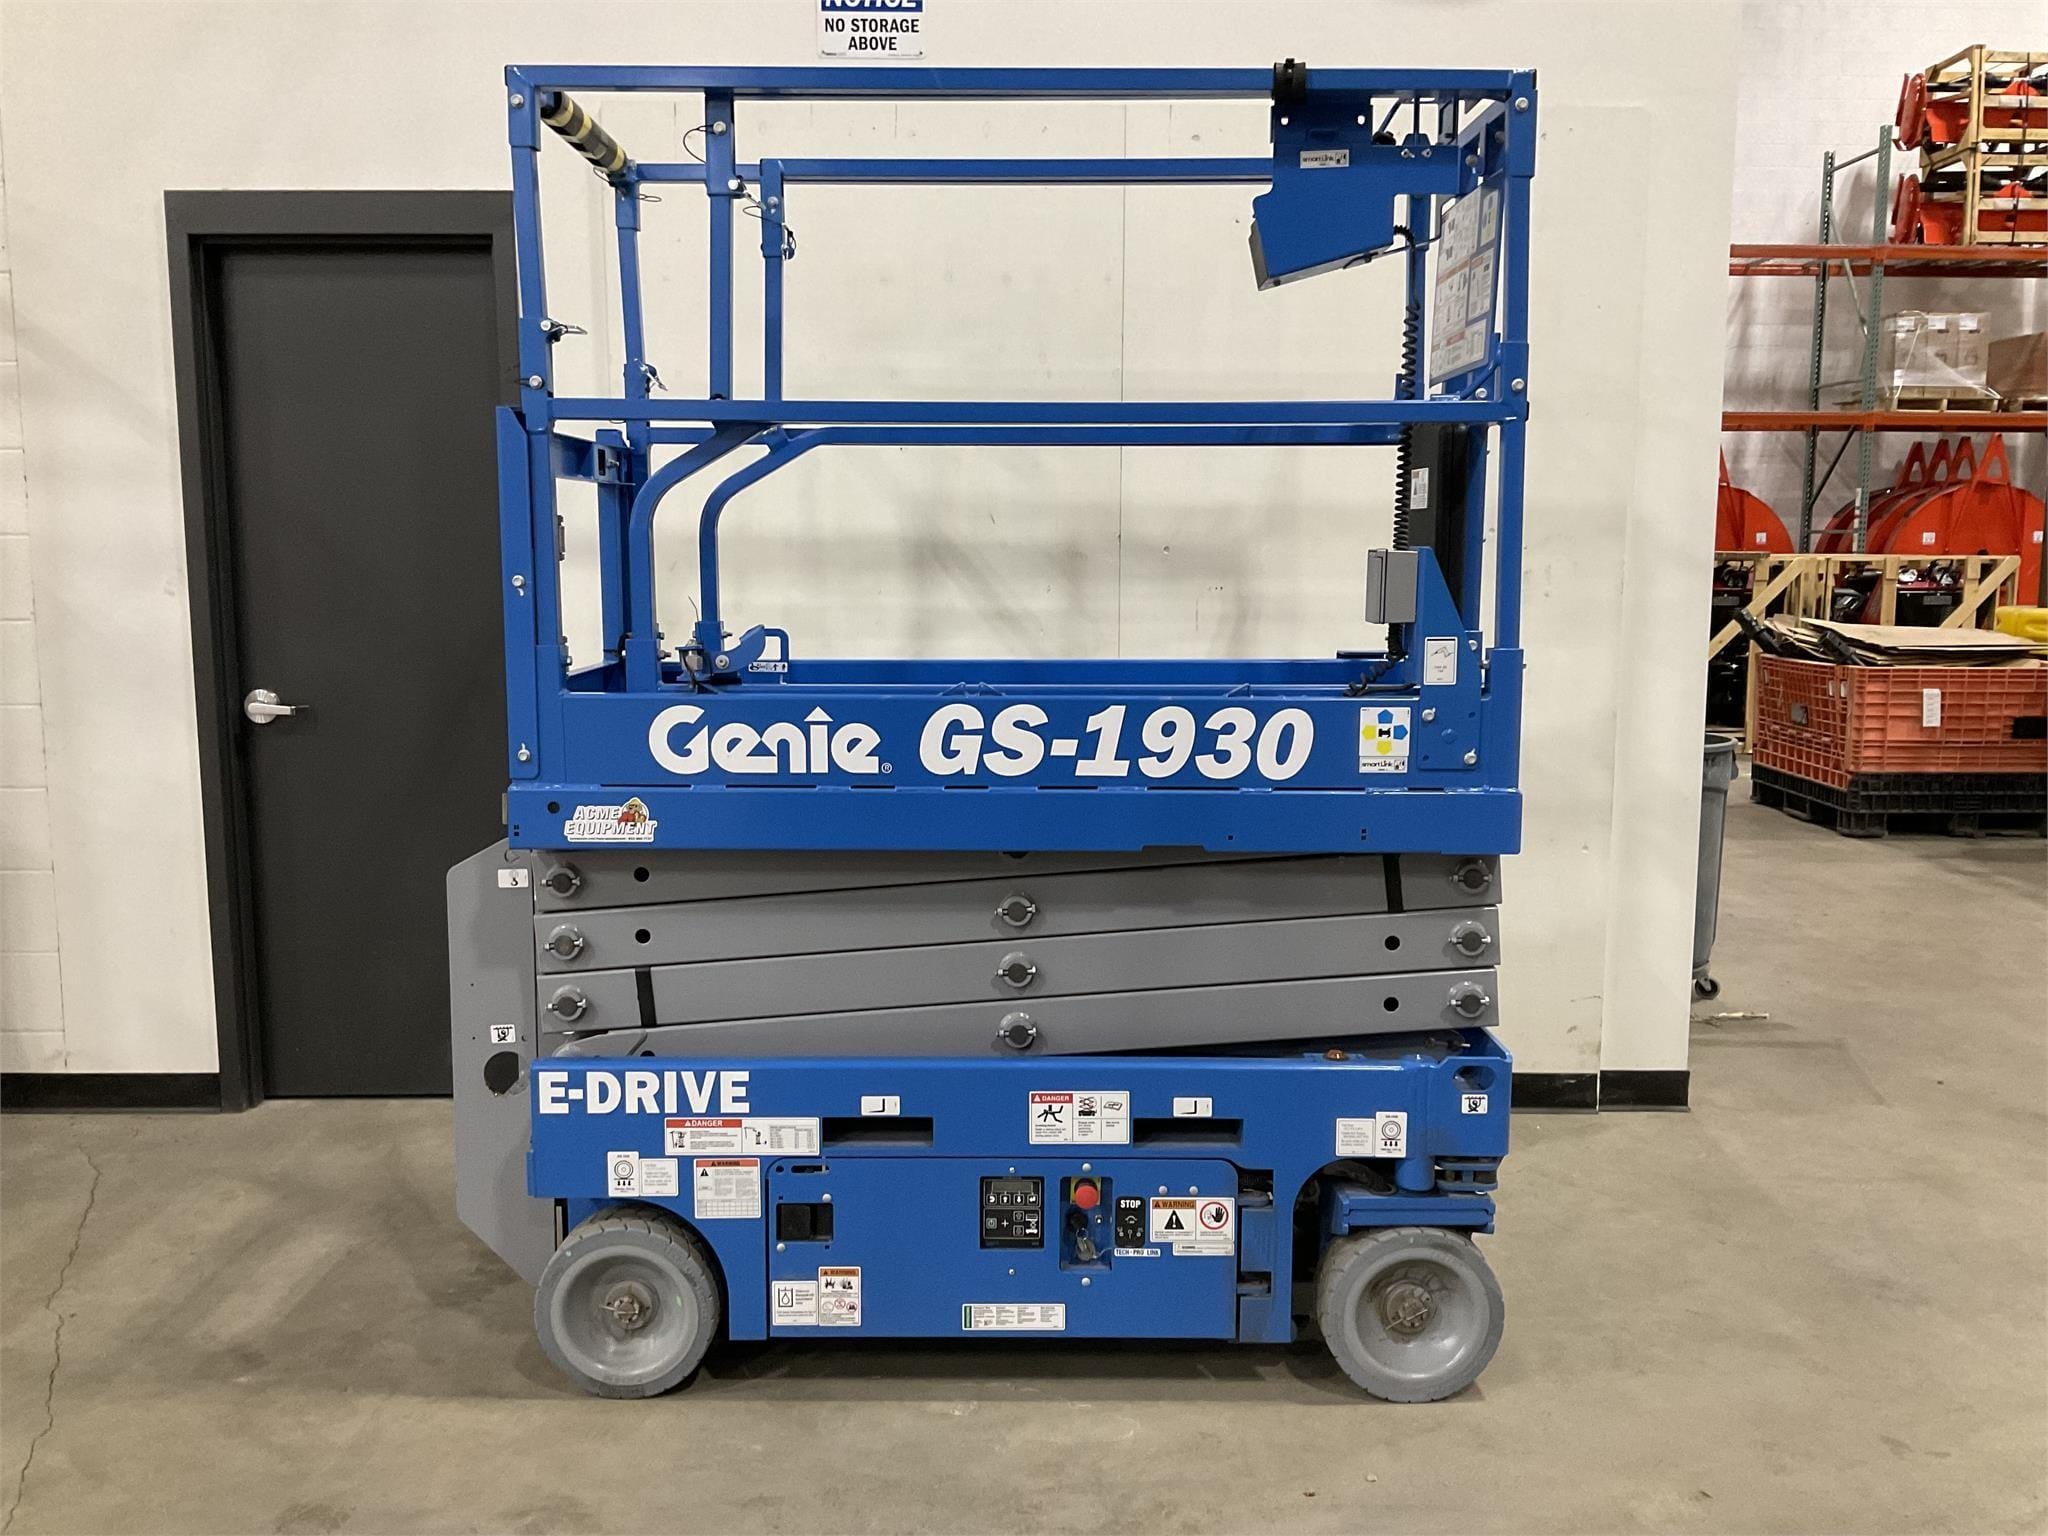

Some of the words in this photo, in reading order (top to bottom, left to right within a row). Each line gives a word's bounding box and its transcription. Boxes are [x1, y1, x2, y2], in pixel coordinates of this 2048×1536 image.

[825, 18, 845, 33] NO
[850, 18, 920, 33] STORAGE
[848, 36, 897, 51] ABOVE
[919, 703, 1314, 780] GS-1930
[575, 807, 620, 821] ACME
[566, 822, 656, 835] EQUIPMENT
[538, 1071, 750, 1114] E-DRIVE
[1120, 1200, 1141, 1209] STOP
